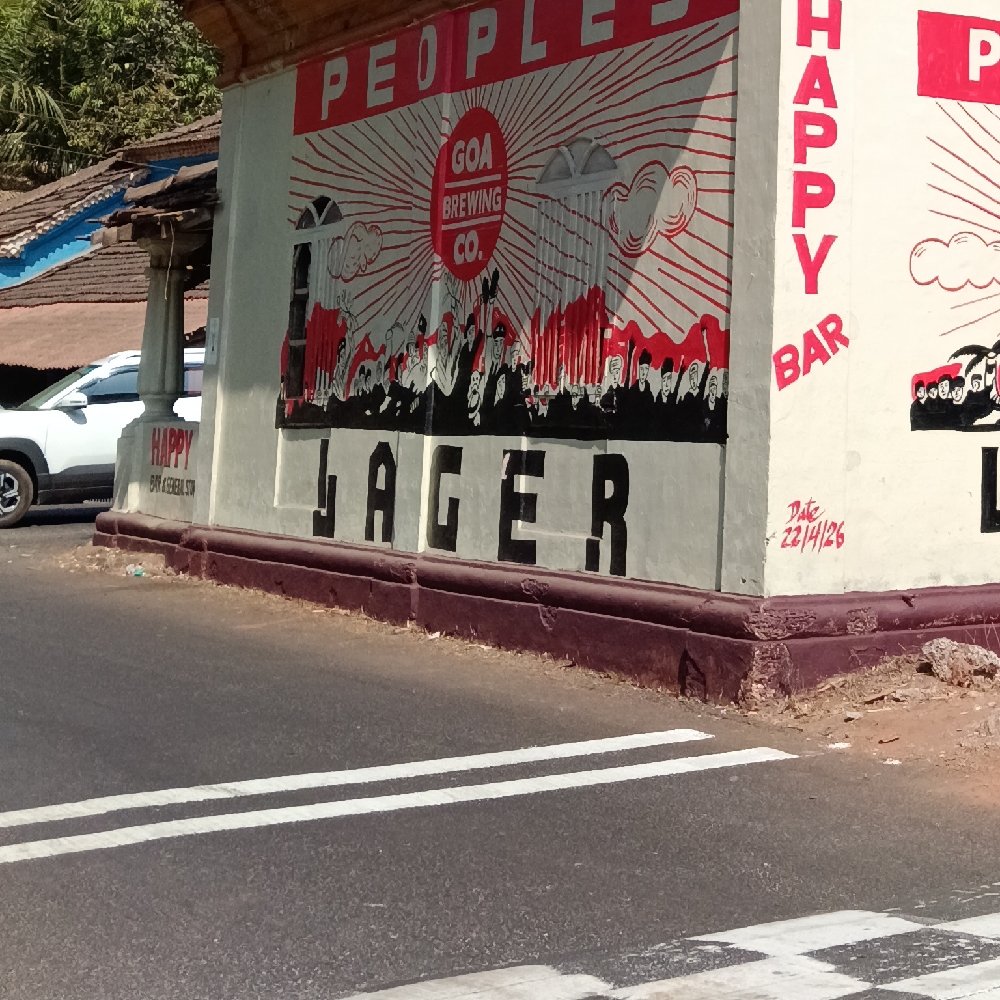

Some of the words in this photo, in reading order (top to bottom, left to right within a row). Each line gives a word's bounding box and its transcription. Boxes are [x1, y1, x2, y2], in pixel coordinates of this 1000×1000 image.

[451, 132, 493, 174] GOA
[442, 186, 502, 220] BREWING
[453, 229, 483, 265] CO.
[772, 313, 850, 391] BAR
[150, 427, 194, 470] HAPPY
[312, 438, 630, 577] LAGER
[786, 497, 826, 525] Date
[781, 519, 845, 554] 22/4/26
